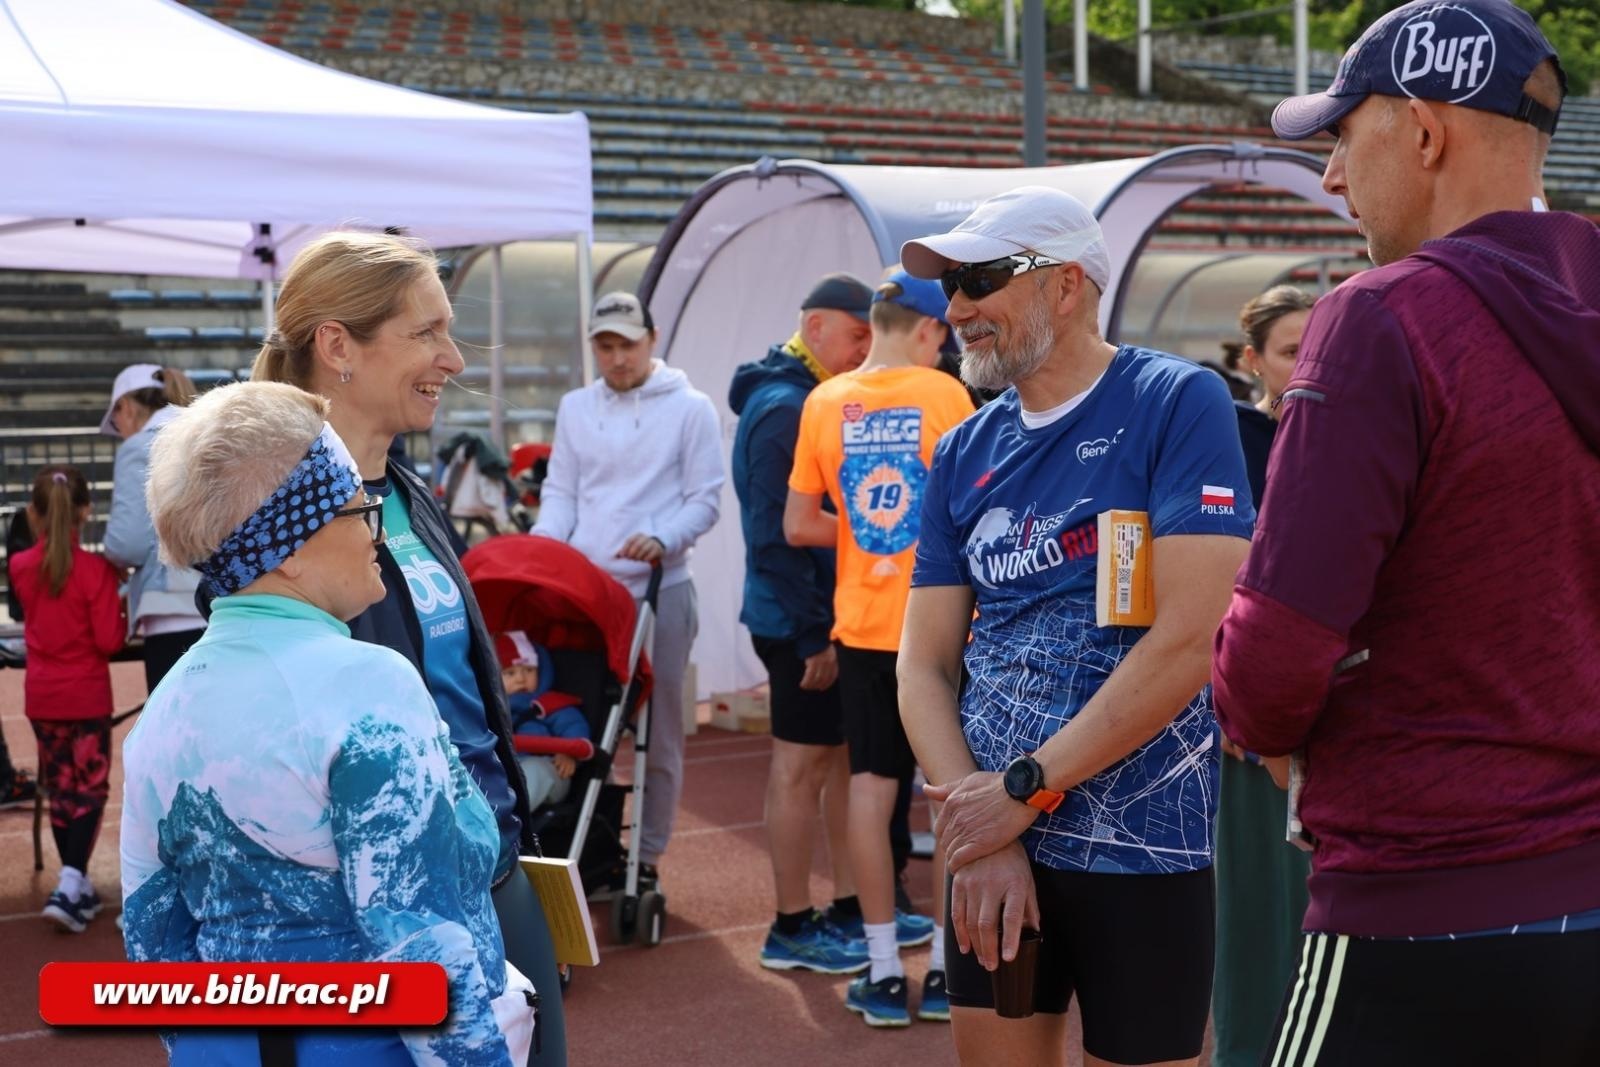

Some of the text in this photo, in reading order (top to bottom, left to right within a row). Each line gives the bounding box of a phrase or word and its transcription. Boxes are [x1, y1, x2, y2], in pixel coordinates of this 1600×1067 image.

[867, 484, 902, 510] 19
[1201, 504, 1235, 516] POLSKA
[1002, 536, 1016, 545] FOR
[986, 537, 1064, 583] WORLD
[1061, 523, 1098, 561] RU
[429, 617, 465, 639] RACIBÓRZ
